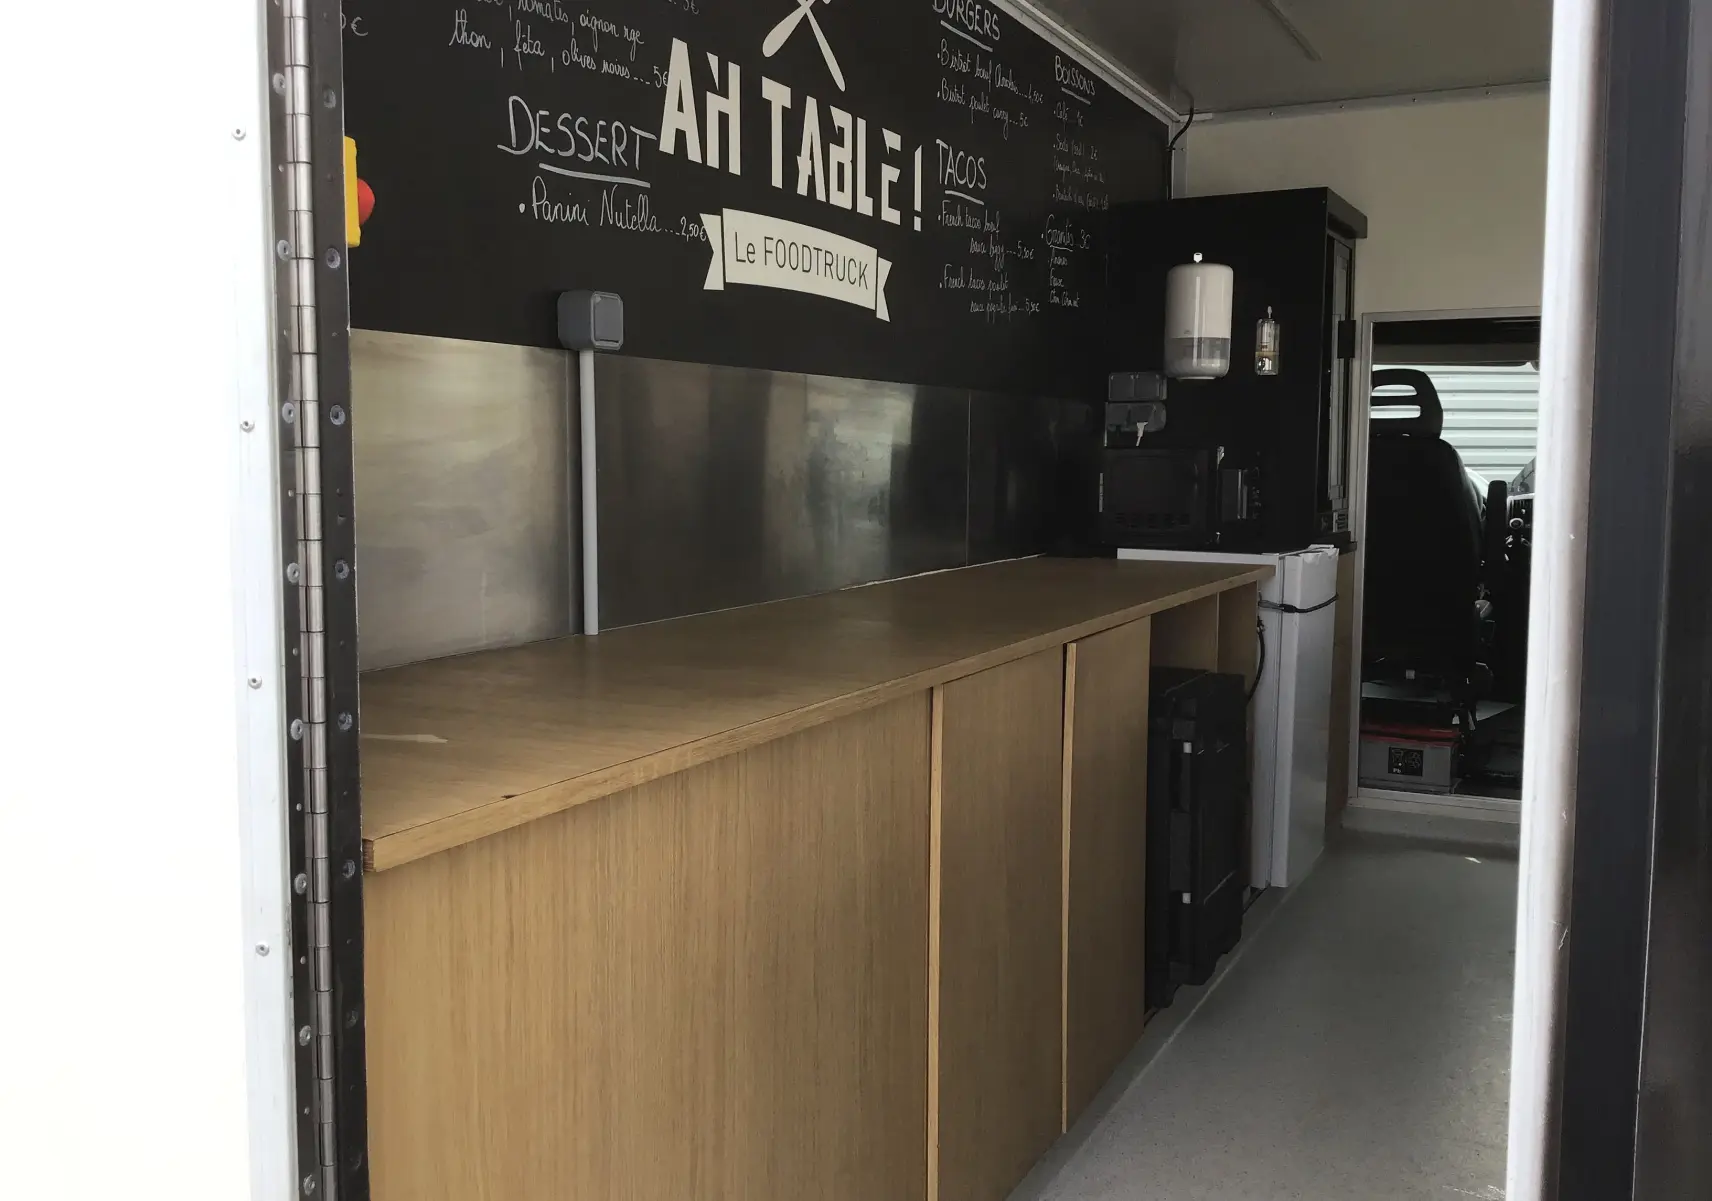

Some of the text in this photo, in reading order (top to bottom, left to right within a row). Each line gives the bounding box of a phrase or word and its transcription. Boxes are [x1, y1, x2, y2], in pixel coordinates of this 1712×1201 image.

[562, 38, 597, 70] olives
[580, 9, 619, 53] oignon
[497, 95, 658, 171] DESSERT
[659, 37, 742, 177] AH
[762, 76, 901, 226] TABLE
[936, 138, 987, 190] TACOS
[531, 176, 707, 242] Panini Nutella 2,50€
[735, 231, 868, 290] Le FOODTRUCK
